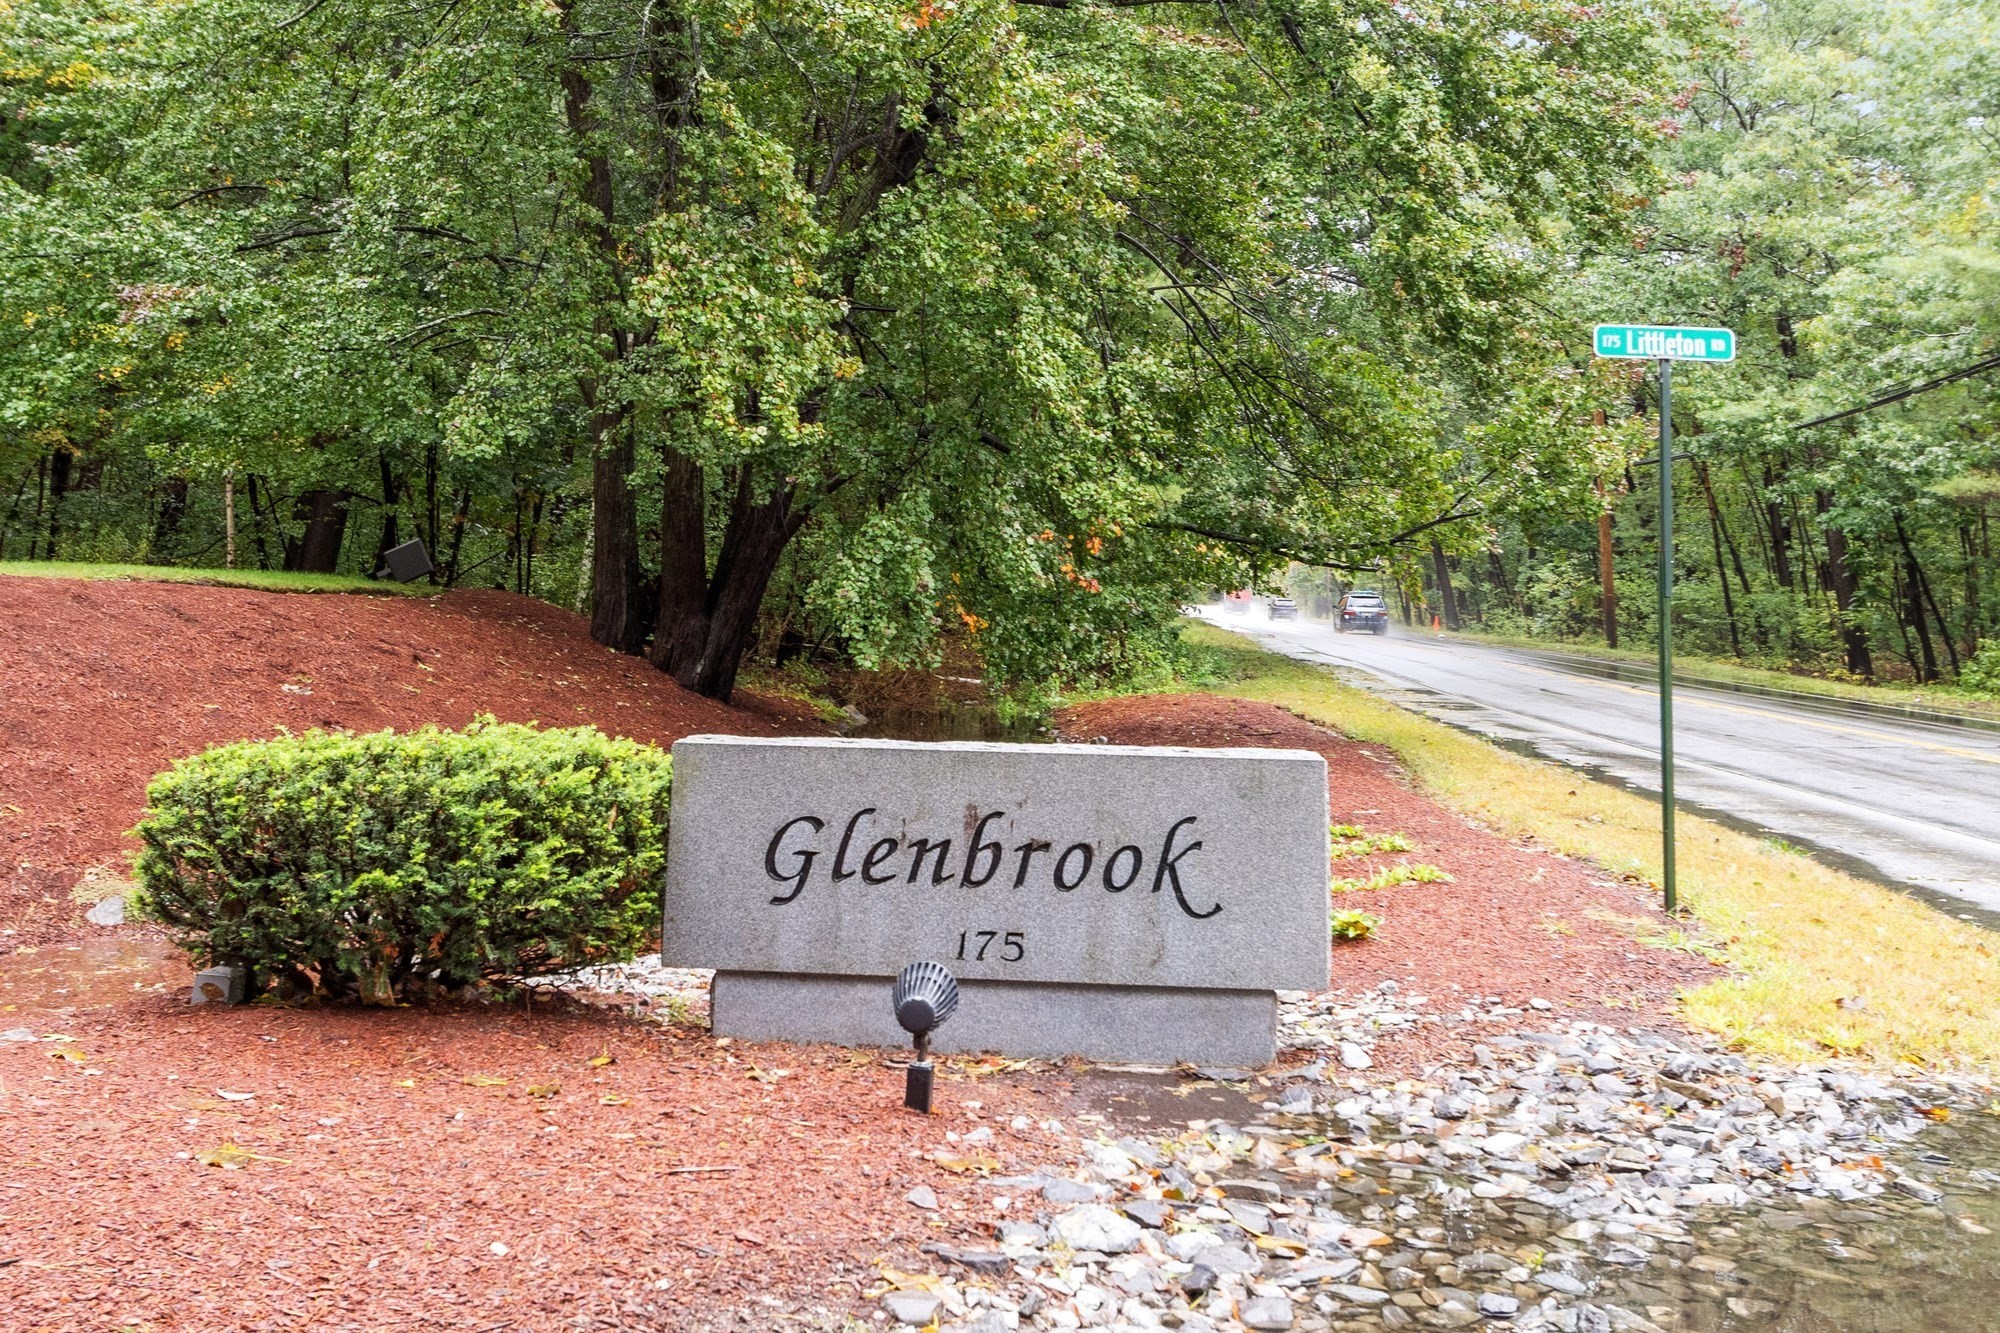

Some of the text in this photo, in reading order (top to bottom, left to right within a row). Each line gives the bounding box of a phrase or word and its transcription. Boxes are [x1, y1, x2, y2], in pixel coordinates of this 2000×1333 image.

[1602, 330, 1726, 356] 175 Littleton RD
[765, 808, 1223, 919] Glenbrook
[955, 929, 1025, 962] 175
